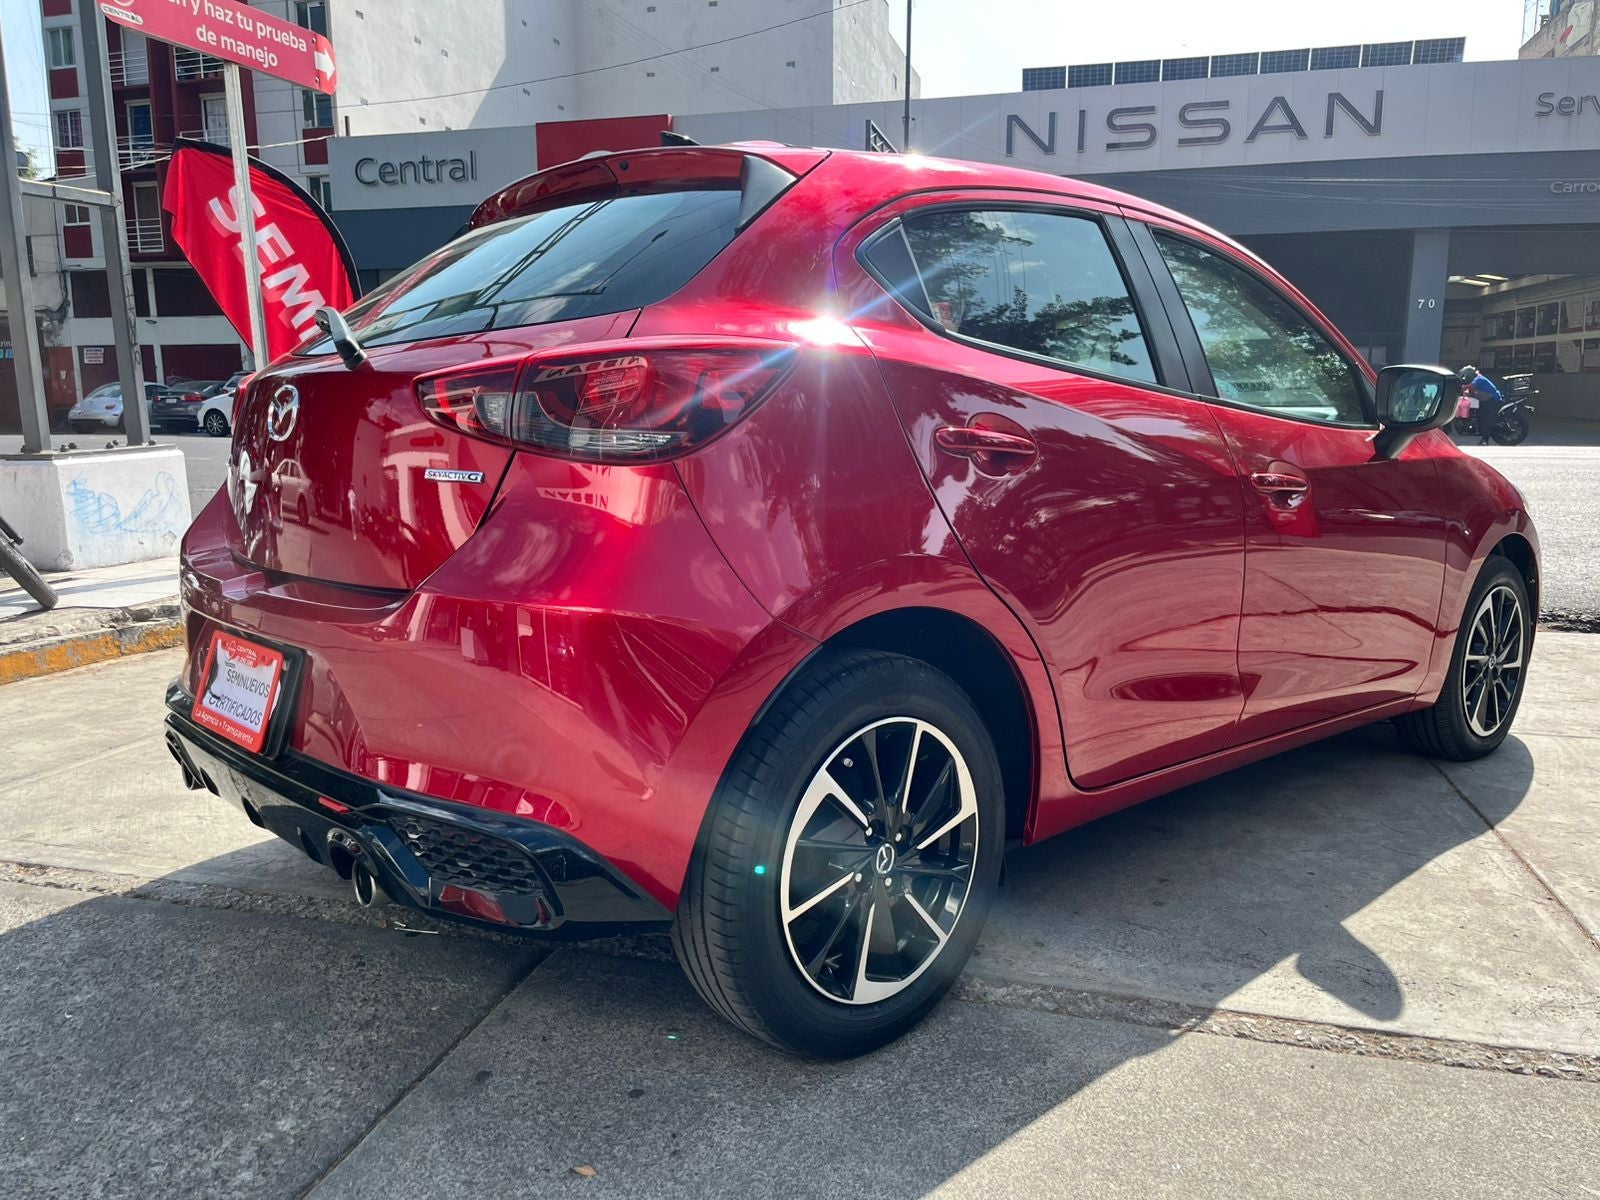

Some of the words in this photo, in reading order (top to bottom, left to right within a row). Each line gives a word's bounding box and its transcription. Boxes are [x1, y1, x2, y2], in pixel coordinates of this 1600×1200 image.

[203, 0, 234, 24] haz
[237, 13, 253, 32] tu
[257, 22, 307, 52] prueba
[195, 24, 217, 46] de
[220, 35, 278, 69] manejo
[1005, 89, 1384, 158] NISSAN
[354, 150, 477, 186] Central
[226, 668, 271, 698] SEMINUEVOS
[209, 693, 263, 726] CERTIFICADOS
[222, 720, 254, 745] Transparente
